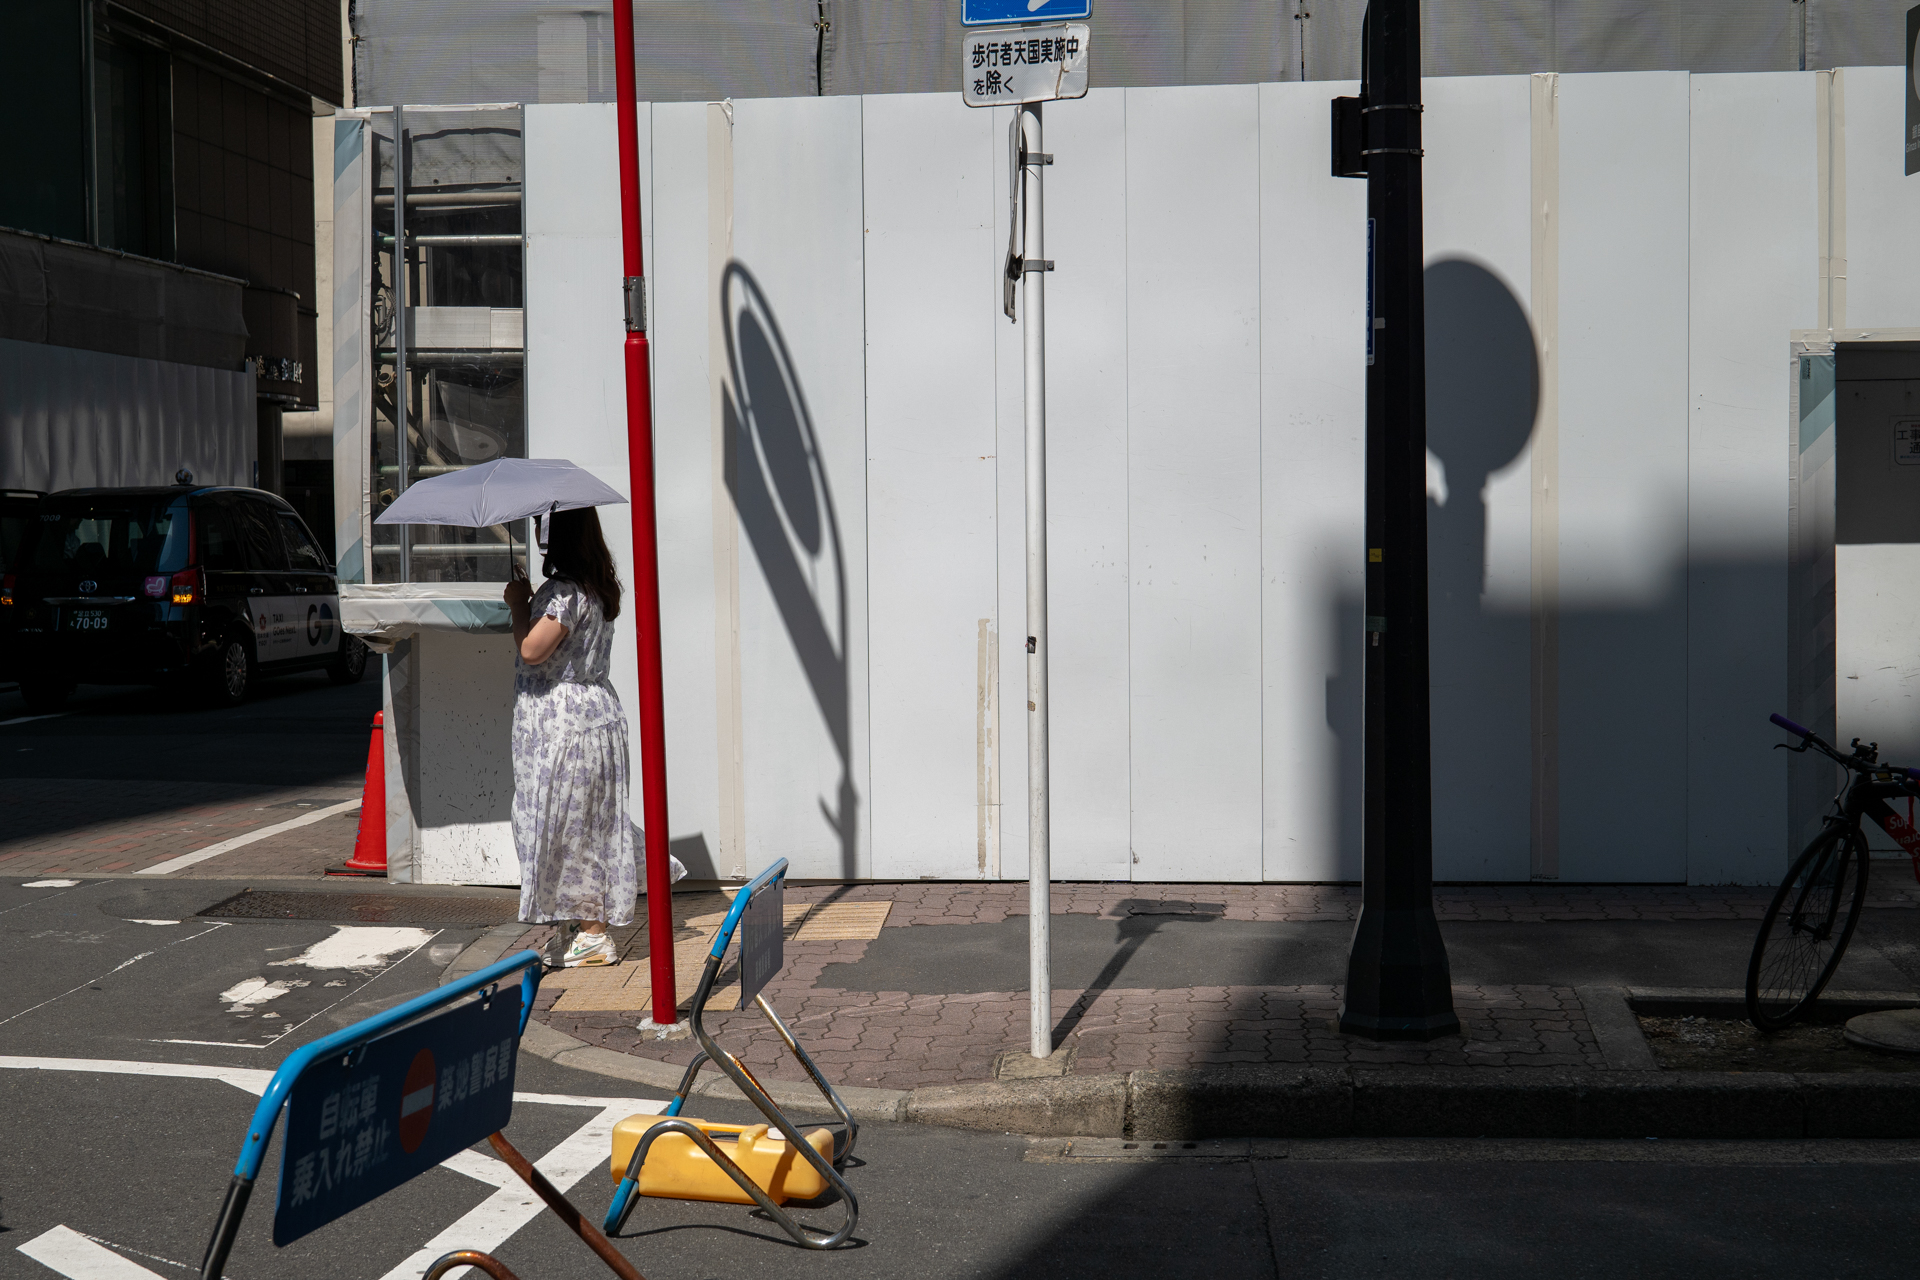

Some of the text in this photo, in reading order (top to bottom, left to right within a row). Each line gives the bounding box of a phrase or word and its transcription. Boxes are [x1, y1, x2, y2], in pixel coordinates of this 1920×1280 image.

[972, 35, 1079, 68] 歩行者天国実施中
[973, 70, 1014, 95] を除く
[39, 514, 61, 522] 7009
[76, 617, 108, 630] 70-09
[437, 1037, 512, 1112] 築地警察署
[319, 1074, 380, 1141] 自転車
[290, 1118, 391, 1208] 乗入れ禁止
